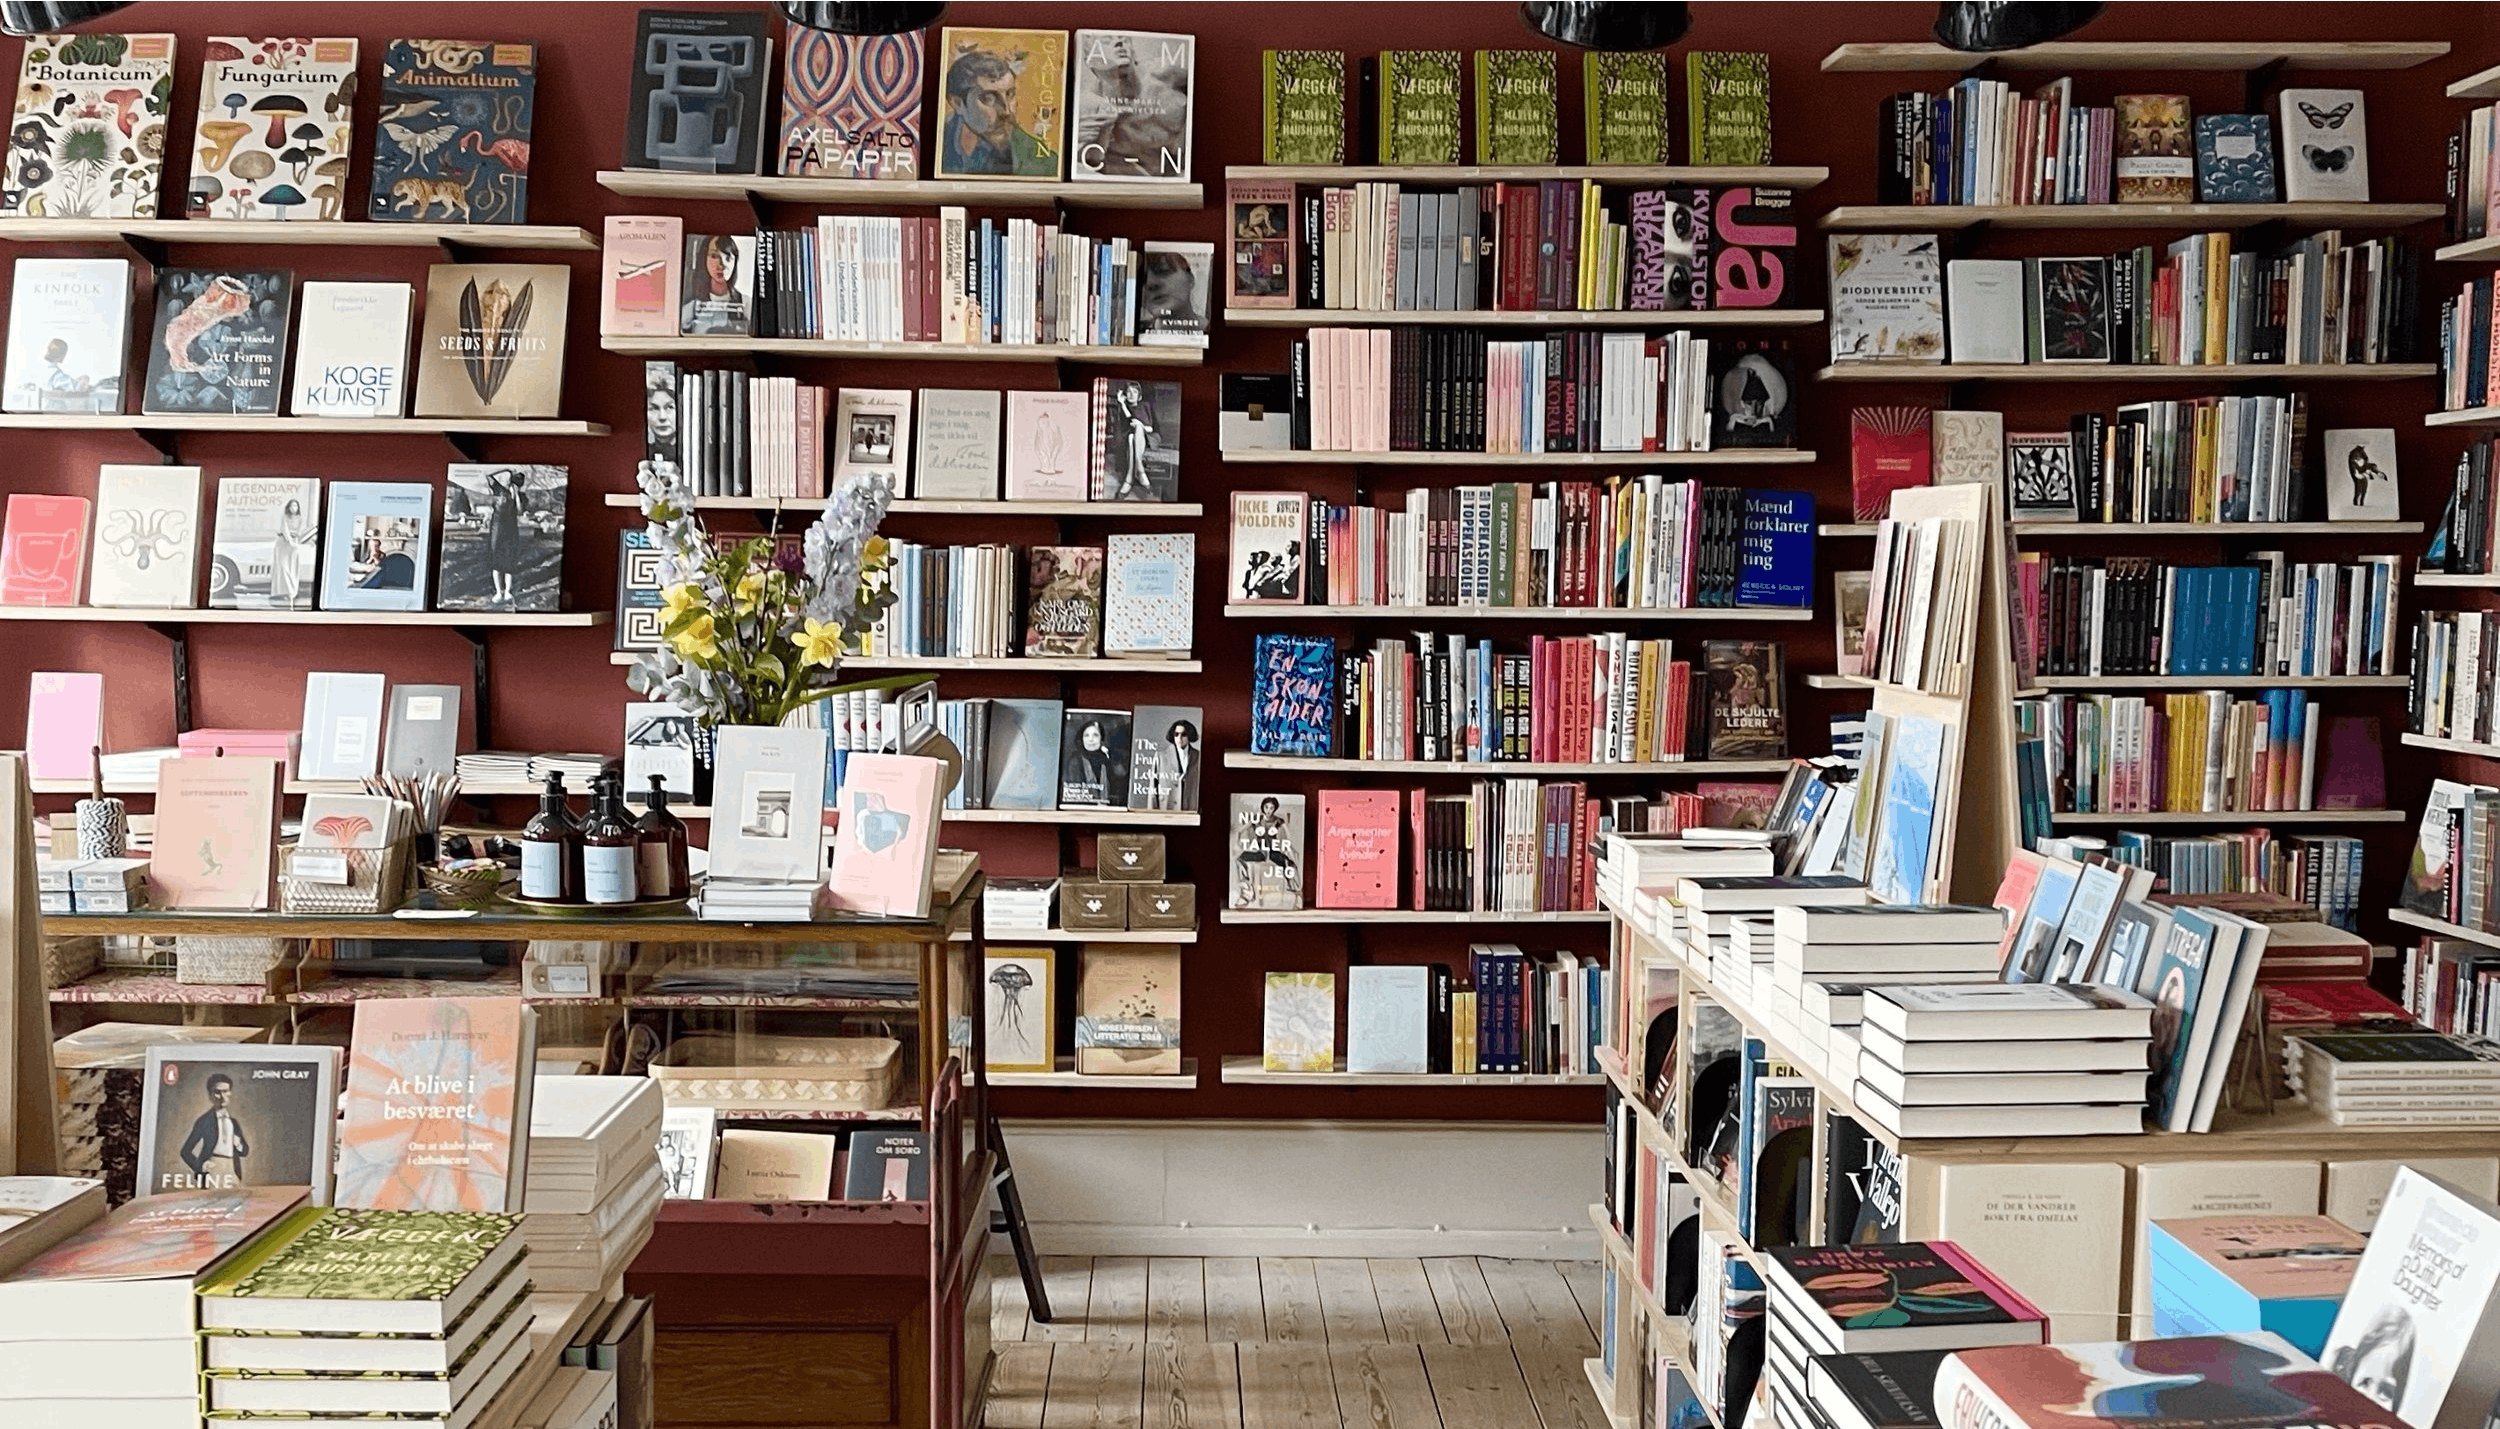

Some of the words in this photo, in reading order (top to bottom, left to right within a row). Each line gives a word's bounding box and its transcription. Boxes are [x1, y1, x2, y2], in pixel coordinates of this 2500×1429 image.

[36, 65, 152, 83] Botanicum
[218, 66, 338, 87] Fungarium
[396, 69, 521, 88] Animalium
[1284, 77, 1337, 95] VÆGGEN
[1399, 77, 1453, 95] VÆGGEN
[1496, 78, 1549, 95] VÆGGEN
[1605, 78, 1659, 96] VÆGGEN
[1710, 78, 1762, 96] VÆGGEN
[1291, 109, 1327, 120] MARLEN
[1406, 109, 1443, 120] MARLEN
[1504, 109, 1540, 121] MARLEN
[1614, 110, 1650, 121] MARLEN
[1718, 110, 1753, 121] MARLEN
[1282, 124, 1335, 136] HAUSHOFER
[1399, 124, 1452, 136] HAUSHOFER
[1495, 125, 1548, 136] HAUSHOFER
[1605, 125, 1659, 136] HAUSHOFER
[1709, 125, 1762, 136] HAUSHOFER
[1755, 187, 1792, 197] Suzanne
[1630, 192, 1650, 310] BRØGGER
[1648, 190, 1666, 310] SUZANNE
[1690, 189, 1711, 310] KVÆLSTOF
[1716, 187, 1797, 308] Ja
[33, 283, 102, 295] KINFOLK
[1841, 286, 1934, 296] BIODIVERSITET
[439, 336, 481, 351] SEEDS
[485, 337, 494, 350] &
[500, 337, 547, 351] FRUITS
[210, 351, 231, 364] Art
[234, 351, 273, 364] Forms
[259, 363, 272, 376] in
[324, 366, 394, 386] KOGE
[226, 375, 271, 388] Nature
[306, 387, 391, 407] KUNST
[1547, 380, 1561, 436] KORAL
[1565, 381, 1577, 436] KRUKKE
[226, 481, 301, 495] LEGENDARY
[226, 496, 283, 507] AUTHORS
[1238, 500, 1269, 514] IKKE
[1745, 498, 1793, 515] Mænd
[1238, 514, 1296, 528] VOLDENS
[1744, 516, 1810, 534] forklarer
[1461, 503, 1475, 597] TOPEKASKOLEN
[1476, 503, 1491, 597] TOPEKASKOLEN
[1743, 535, 1774, 552] mig
[1742, 552, 1774, 571] ting
[1269, 648, 1296, 673] EN
[1613, 650, 1622, 686] SHE
[1504, 660, 1514, 686] FIGHT
[1519, 660, 1529, 686] FIGHT
[1628, 651, 1640, 688] ROXANE
[1266, 672, 1324, 700] SKØN
[1627, 690, 1639, 708] GAY
[1263, 698, 1325, 727] ALDER
[1714, 707, 1729, 718] DE
[1731, 707, 1781, 718] SKJULTE
[1726, 718, 1769, 729] LEDERE
[1609, 710, 1618, 759] SAID
[1135, 738, 1158, 751] The
[1133, 782, 1172, 796] Reader
[1238, 812, 1262, 825] NU
[1240, 838, 1292, 853] TALER
[1345, 837, 1374, 849] mod
[1263, 866, 1296, 879] JEG
[1094, 1032, 1140, 1040] LITTERATUR
[252, 1070, 281, 1080] JOHN
[282, 1070, 310, 1080] GRAY
[385, 1077, 413, 1096] At
[414, 1075, 464, 1095] blive
[467, 1075, 475, 1094] i
[384, 1101, 475, 1121] besværet
[408, 1141, 427, 1151] Om
[439, 1141, 466, 1151] skabe
[884, 1138, 915, 1147] NOTER
[876, 1146, 894, 1155] OM
[895, 1146, 922, 1155] SORG
[162, 1173, 234, 1189] FELINE
[1868, 1162, 1900, 1230] Vallejo
[1986, 1202, 2000, 1211] DE
[2003, 1202, 2025, 1211] DER
[2028, 1202, 2077, 1211] VANDRER
[1984, 1213, 2011, 1222] BORT
[2014, 1213, 2034, 1222] FRA
[2036, 1213, 2079, 1222] OMELAS
[328, 1226, 487, 1245] VÆGGEN
[323, 1251, 432, 1263] MARLEN
[2409, 1233, 2453, 1275] Memoirs
[283, 1262, 442, 1276] HAUSHOFER
[2392, 1268, 2443, 1311] Daughter
